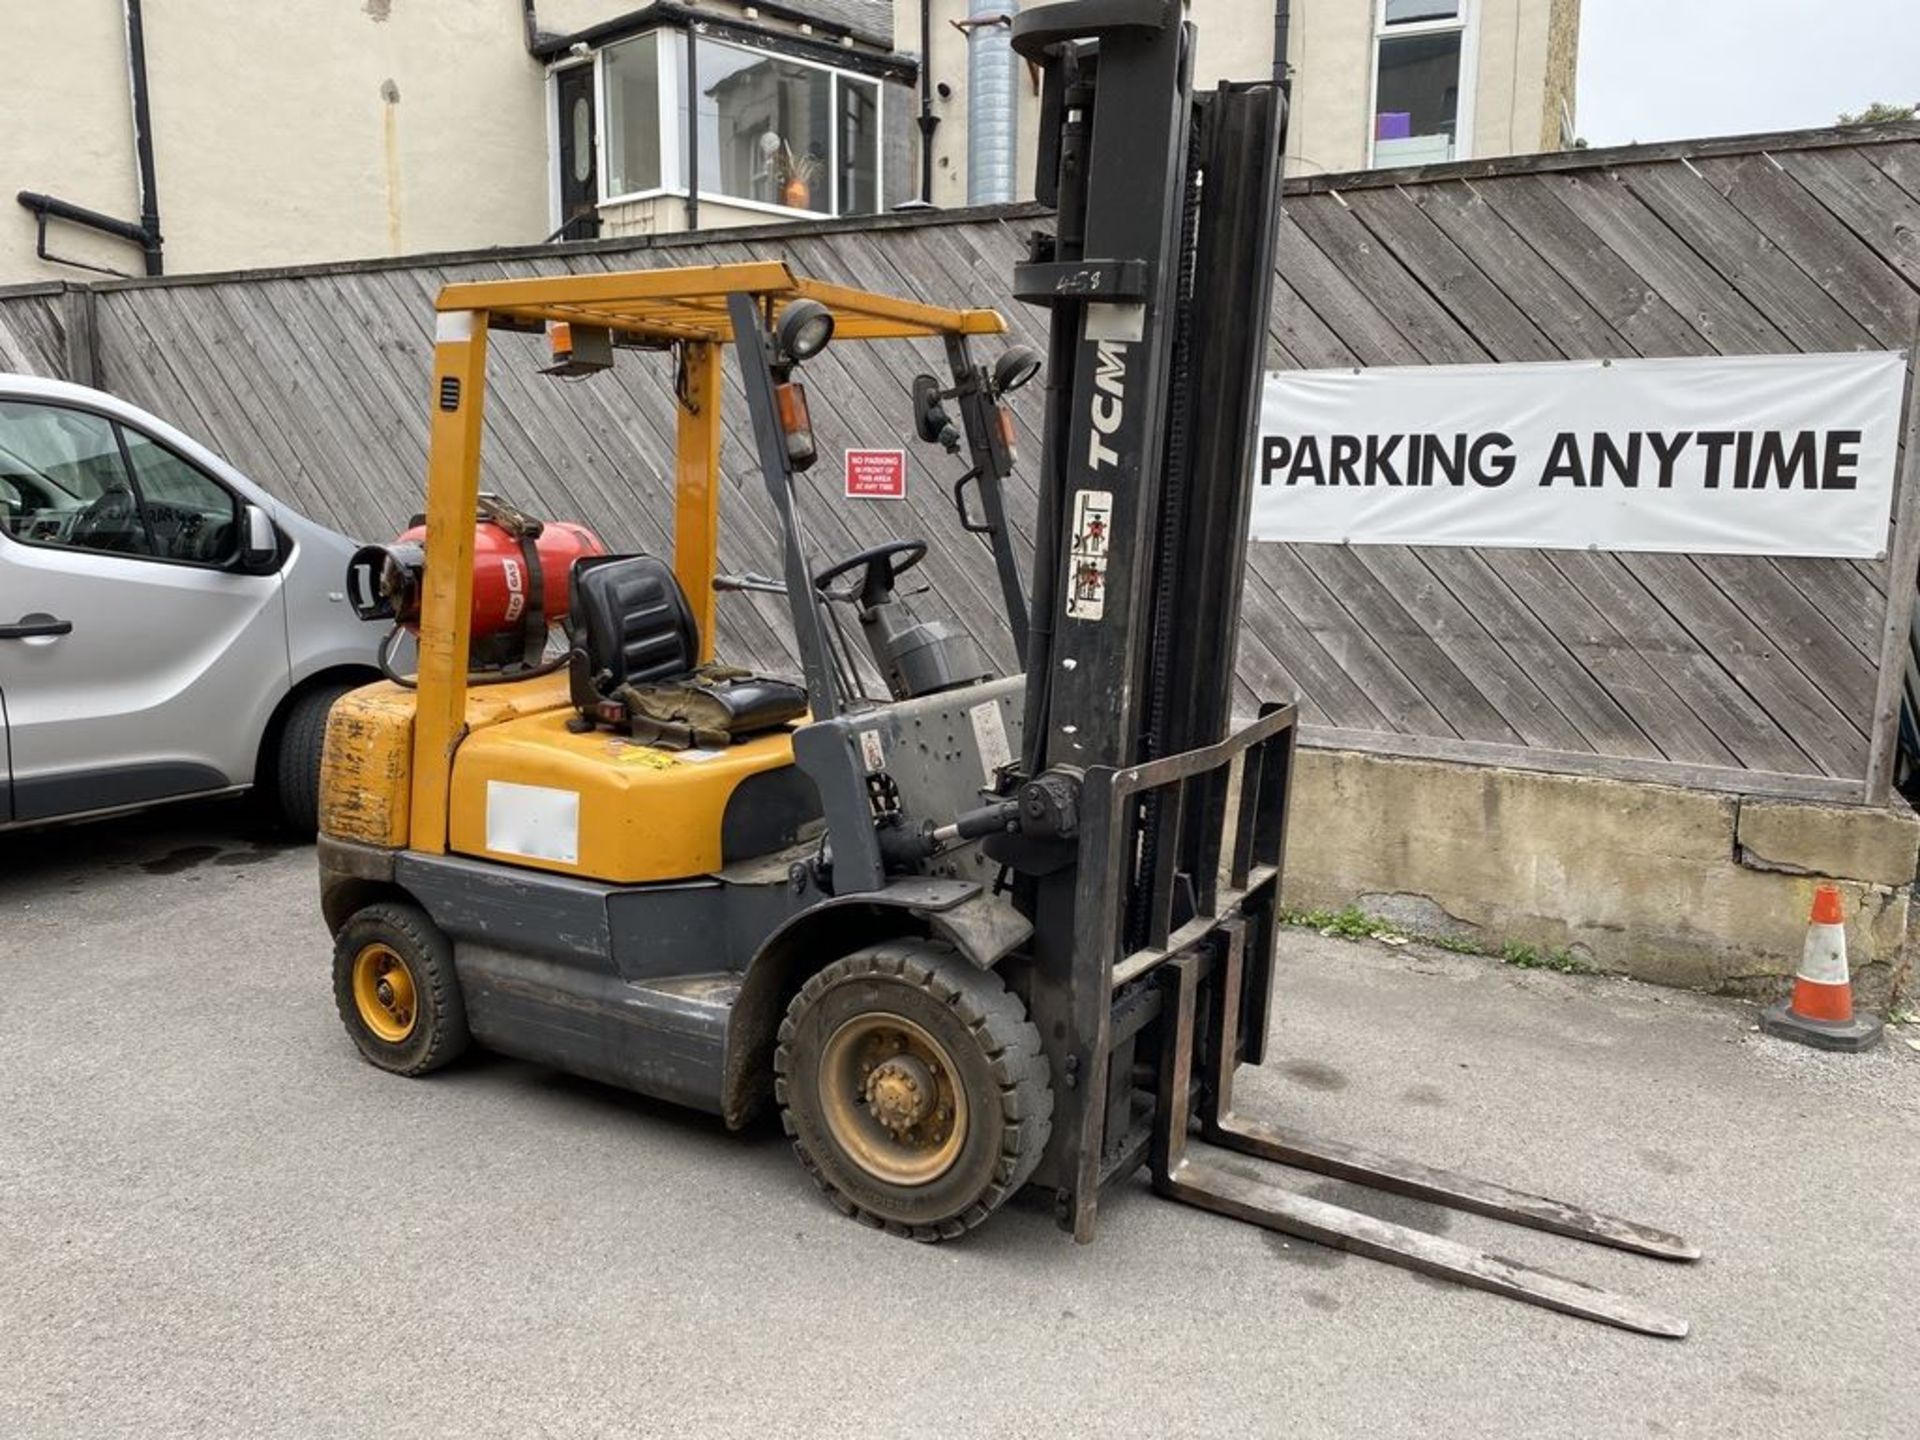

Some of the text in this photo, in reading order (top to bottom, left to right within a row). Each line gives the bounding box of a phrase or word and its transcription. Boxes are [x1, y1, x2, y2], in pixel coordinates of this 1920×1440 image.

[1088, 340, 1128, 471] TCM
[851, 456, 898, 465] NO PARKING
[1260, 430, 1863, 490] PARKING ANYTIME
